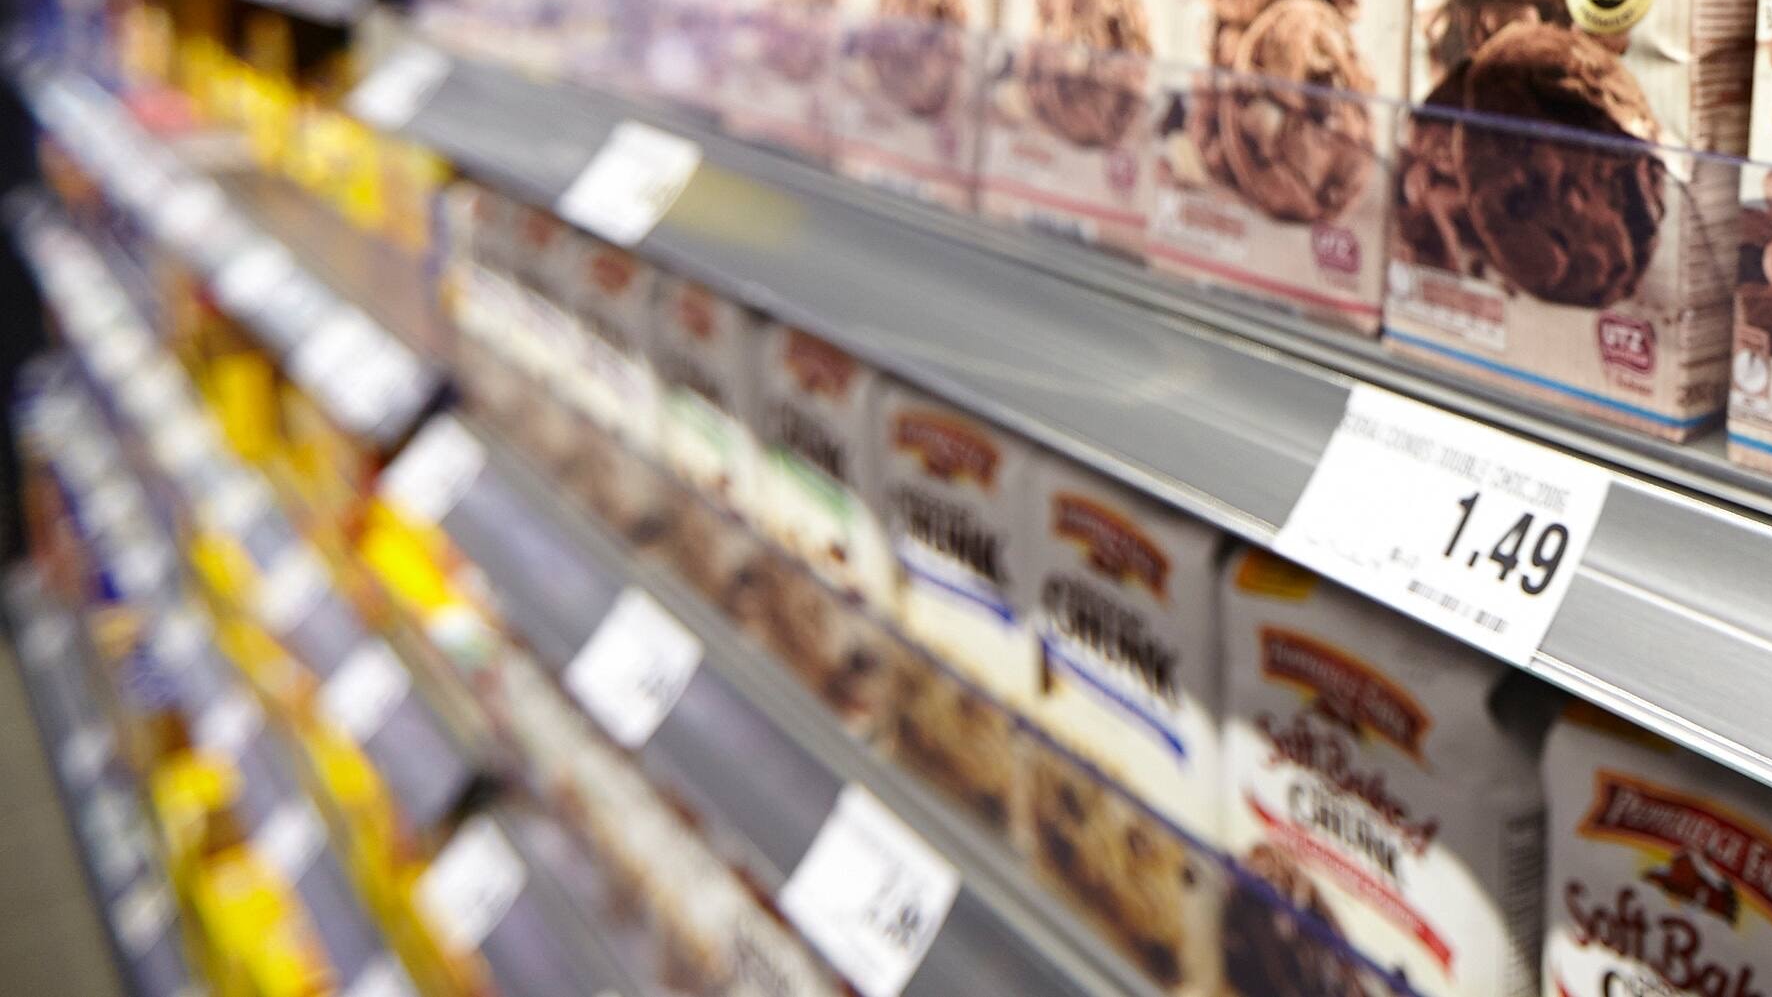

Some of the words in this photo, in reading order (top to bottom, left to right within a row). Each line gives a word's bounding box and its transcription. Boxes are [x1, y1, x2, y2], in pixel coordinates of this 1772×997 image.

[1442, 491, 1570, 596] 1.49
[1564, 876, 1649, 957] Soft
[1658, 913, 1765, 997] Bak
